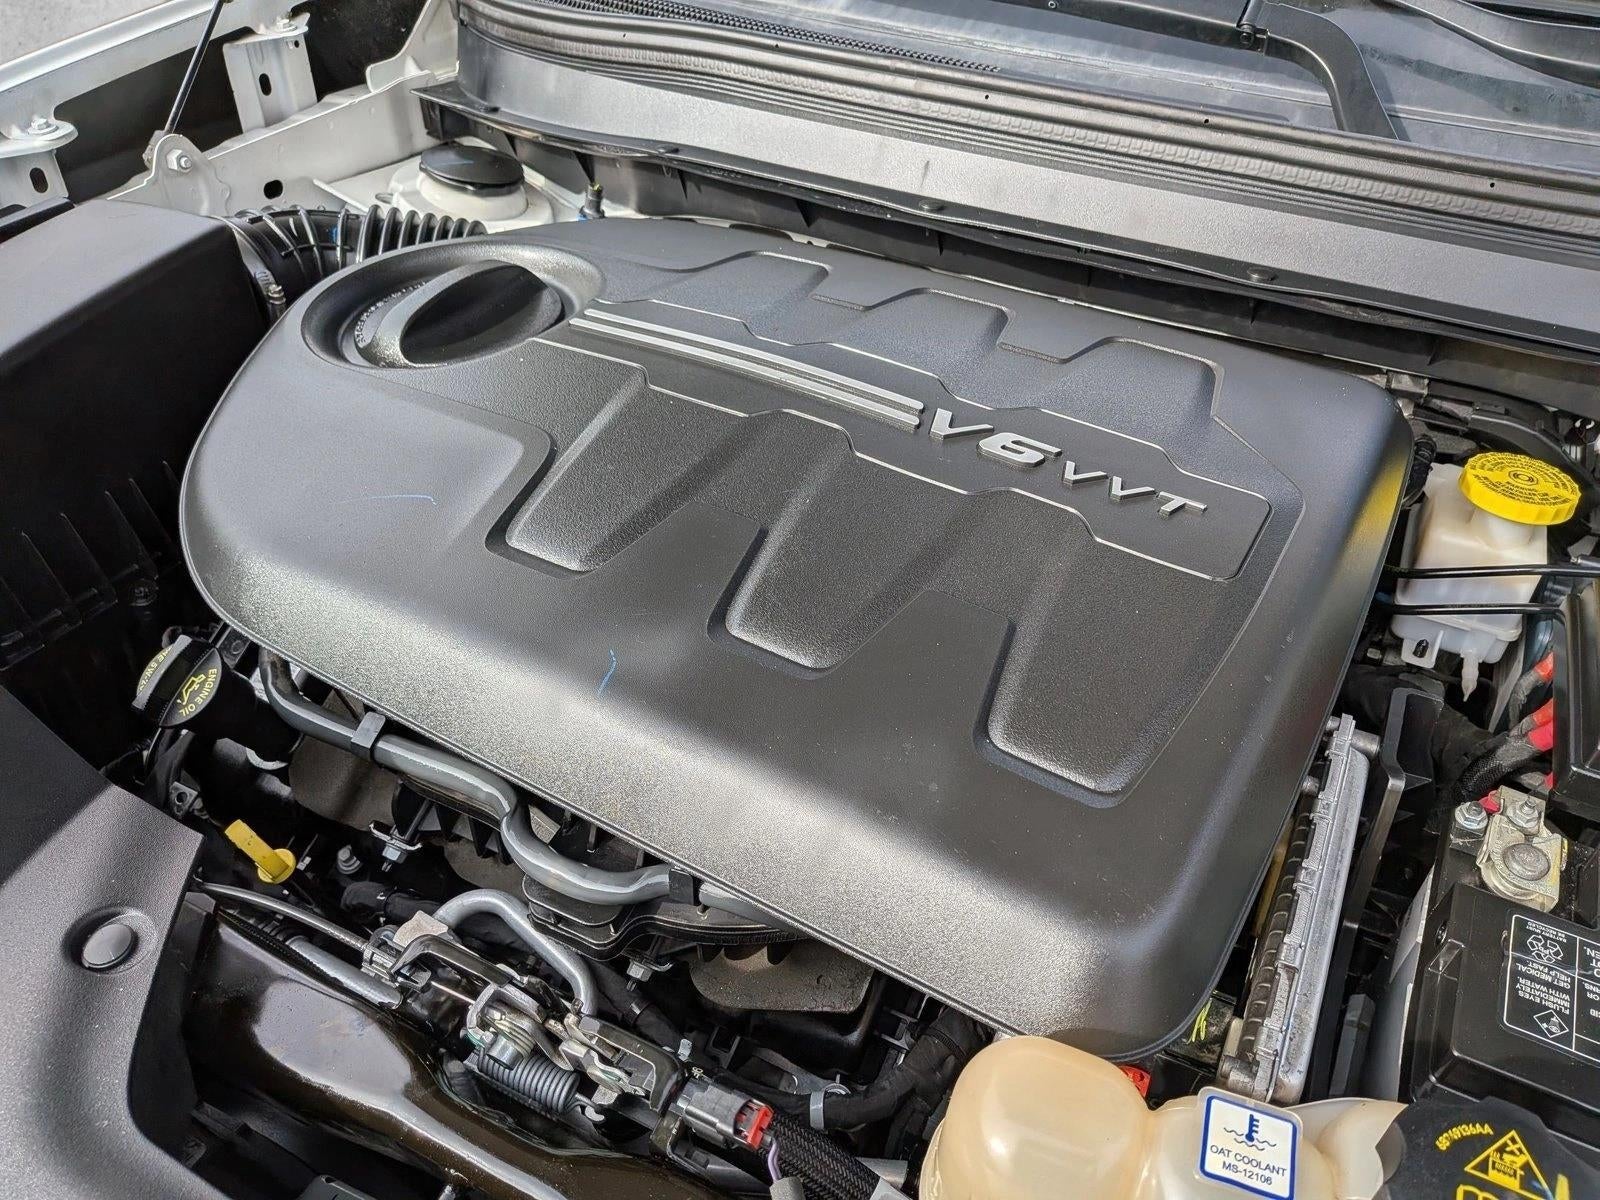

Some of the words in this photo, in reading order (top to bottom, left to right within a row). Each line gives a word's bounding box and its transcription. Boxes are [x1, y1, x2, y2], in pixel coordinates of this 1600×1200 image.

[929, 407, 1062, 468] V6
[1062, 460, 1208, 516] VVT
[195, 668, 217, 704] ENGINE
[180, 703, 196, 717] OIL
[1516, 963, 1552, 982] MEDICAL
[1527, 960, 1548, 973] FAST.
[1550, 970, 1571, 983] HELP
[1553, 979, 1571, 989] GET
[1518, 976, 1548, 993] WATER.
[1516, 983, 1570, 1008] IMMEDIATELY
[1518, 990, 1540, 1003] EYES
[1549, 988, 1570, 1001] WITH
[1542, 1001, 1570, 1015] FLUSH
[1210, 1145, 1232, 1158] OAT
[1234, 1152, 1287, 1177] COOLANT
[1222, 1161, 1272, 1186] MS-12106
